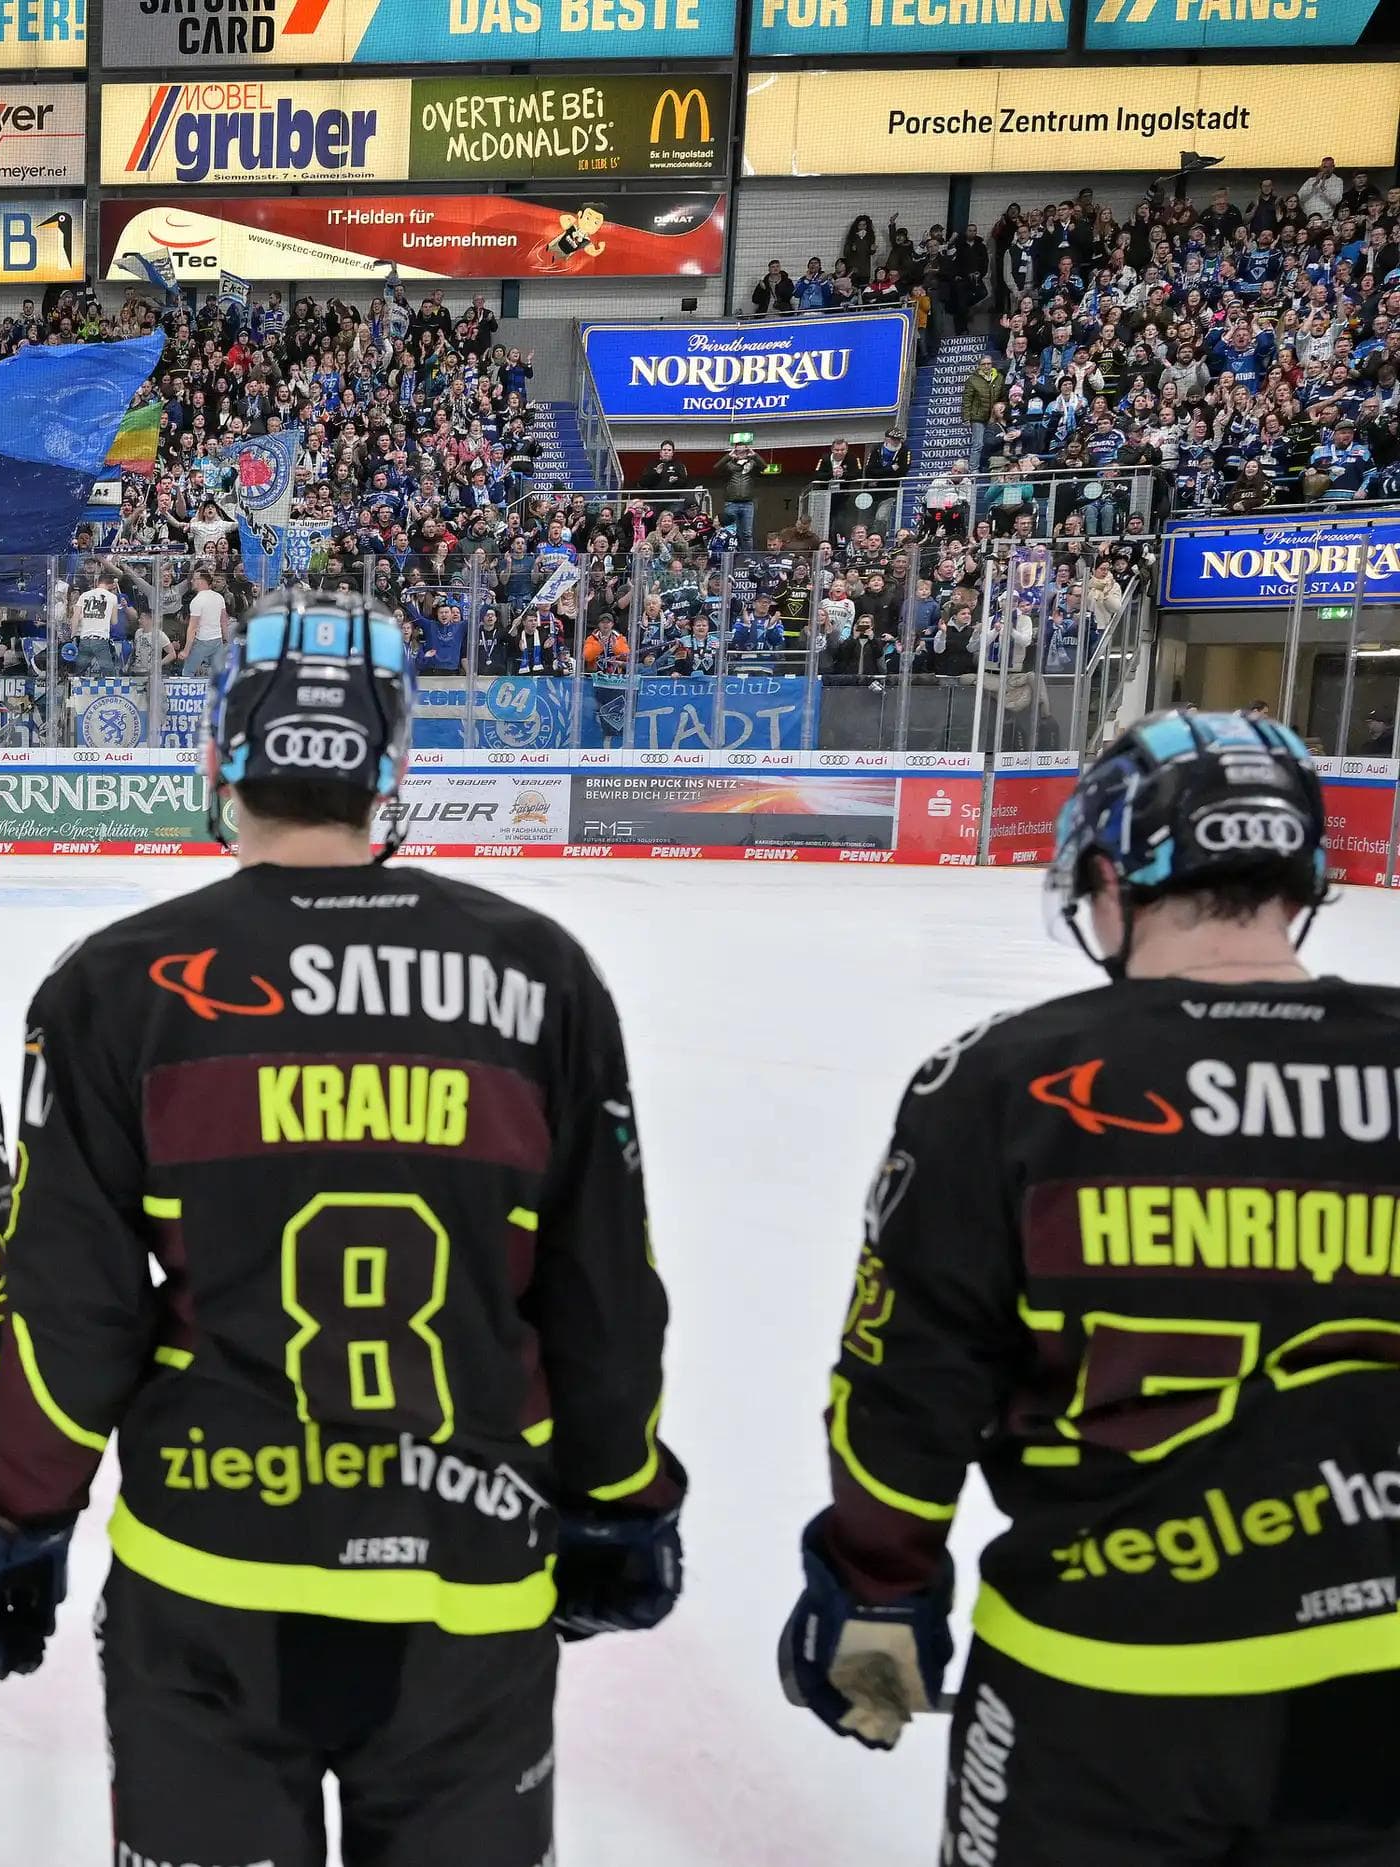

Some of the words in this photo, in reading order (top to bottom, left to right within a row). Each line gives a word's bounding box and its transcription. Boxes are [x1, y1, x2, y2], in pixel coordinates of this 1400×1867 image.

[178, 16, 275, 54] CARD
[183, 83, 273, 111] MÖBEL
[889, 109, 993, 134] Porsche
[999, 108, 1109, 133] Zentrum
[1116, 105, 1250, 137] Ingolstadt
[174, 98, 378, 184] gruber
[649, 161, 712, 169] www.mcdonalds.de
[661, 151, 670, 159] in
[671, 149, 714, 160] Ingolstadt
[213, 172, 280, 182] Siemensstr.
[282, 172, 289, 181] 7
[300, 171, 375, 181] Gaimersheim
[327, 209, 404, 225] IT-Helden
[409, 209, 435, 225] für
[402, 232, 517, 248] Unternehmen
[687, 333, 794, 352] Privatbrauerei
[628, 348, 852, 393] NORDBRÄU
[683, 394, 790, 411] INGOLSTADT
[1199, 542, 1400, 582] NORDBRÄ
[316, 622, 336, 647] 8
[495, 682, 531, 713] 64
[104, 752, 133, 761] Audi
[520, 753, 550, 763] Audi
[673, 753, 704, 764] Audi
[854, 755, 888, 765] Audi
[586, 778, 622, 789] BRING
[624, 778, 648, 789] DEN
[650, 779, 683, 790] PUCK
[684, 779, 705, 790] INS
[707, 780, 737, 790] NETZ
[585, 790, 630, 801] BEWIRB
[632, 790, 661, 801] DICH
[663, 790, 702, 802] JETZT!
[584, 821, 634, 837] FMS
[289, 944, 548, 1045] SATURN
[1186, 1058, 1400, 1142] SATU
[1077, 1185, 1400, 1284] HENRIQU
[281, 1191, 454, 1445] 8
[160, 1426, 525, 1521] zieglerhaus
[1052, 1458, 1400, 1582] zieglerha
